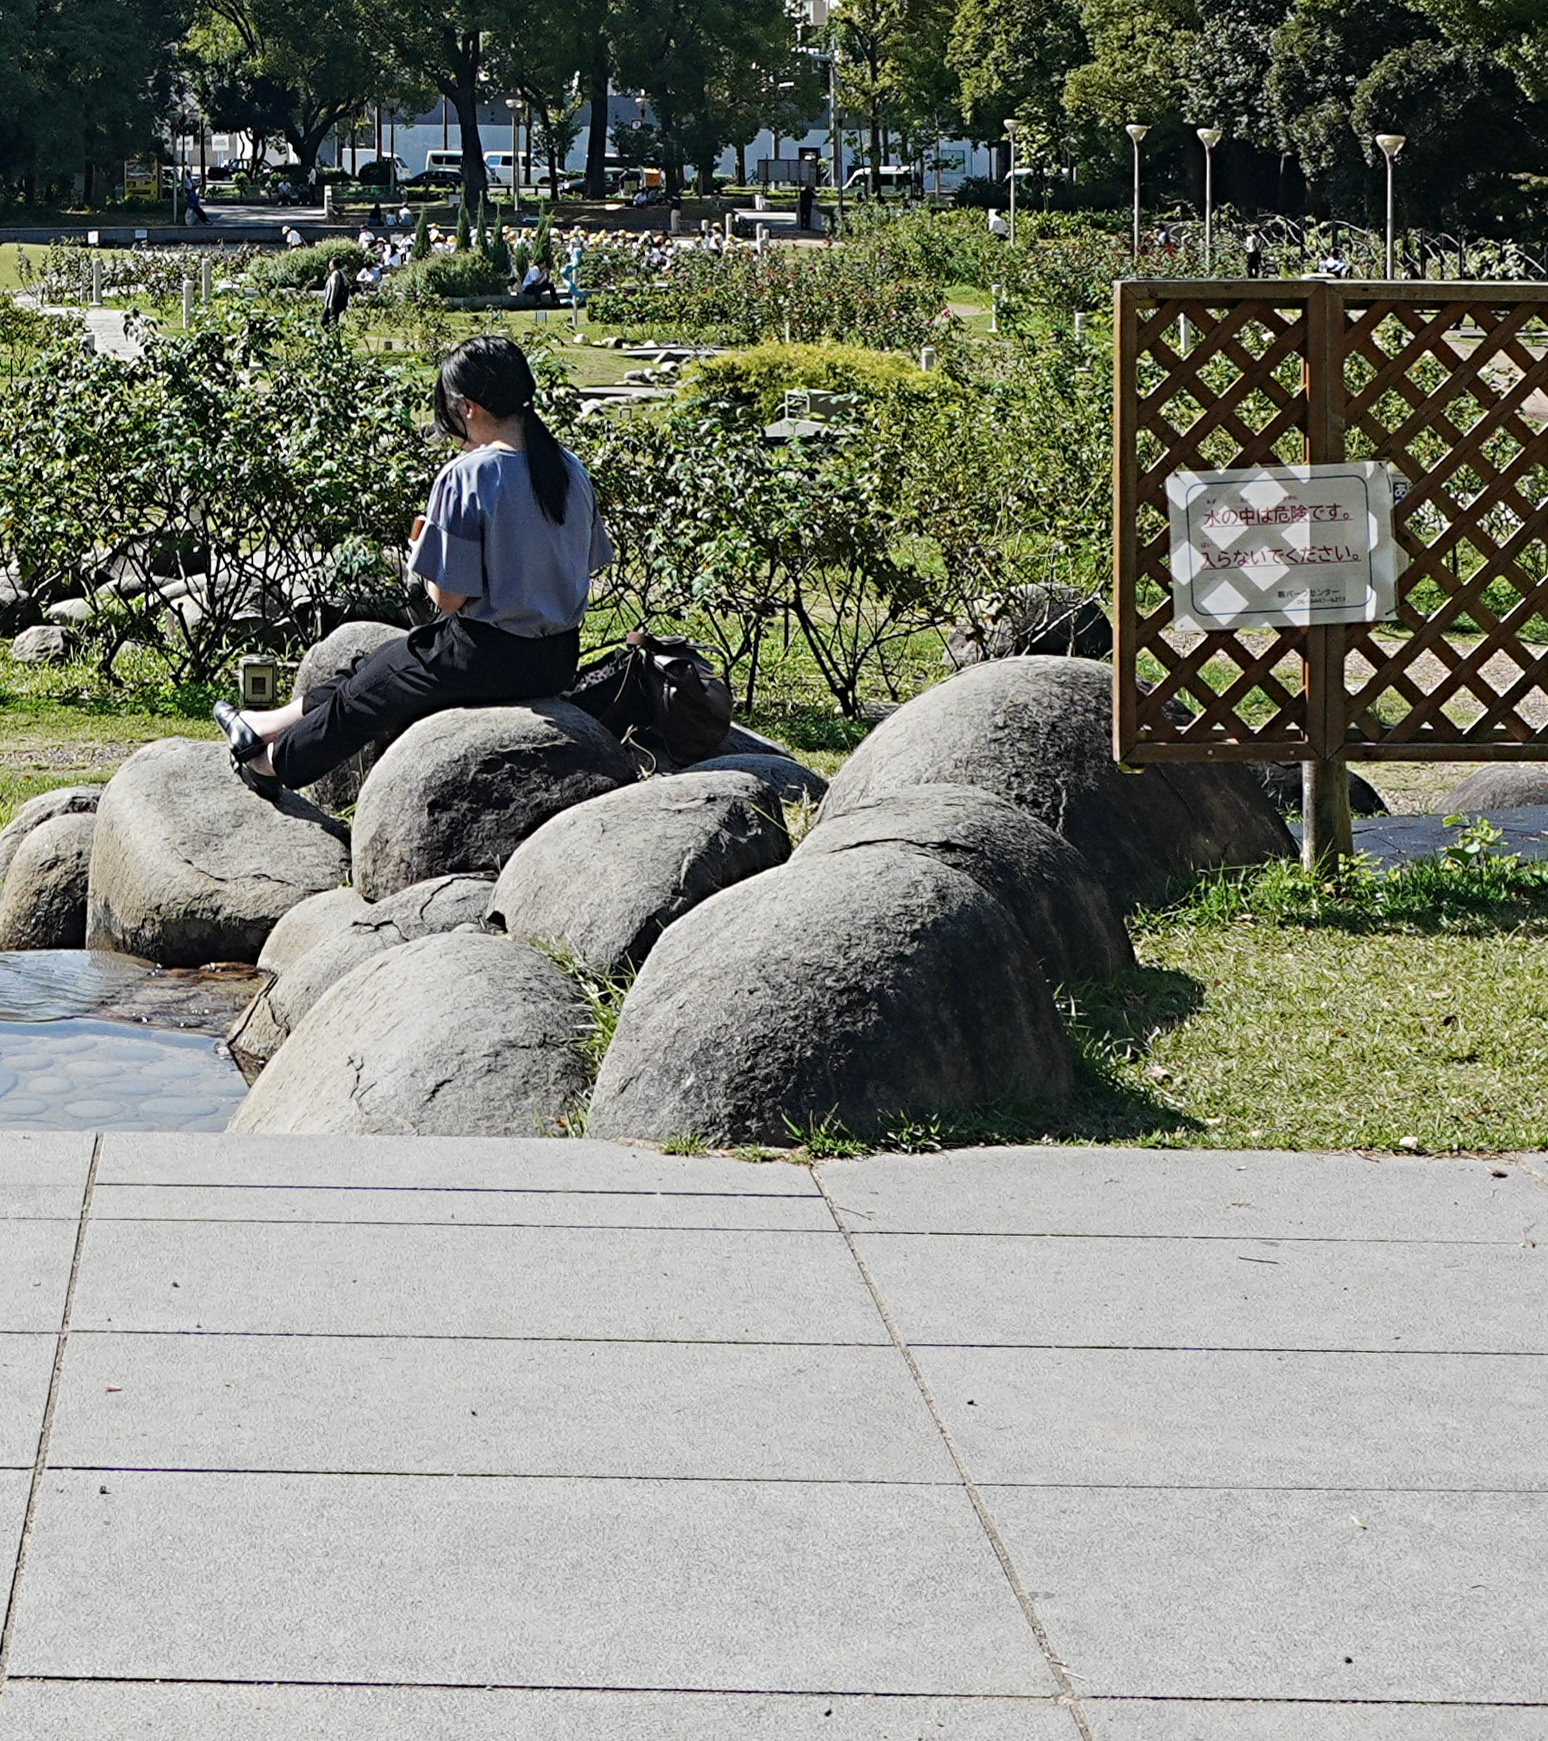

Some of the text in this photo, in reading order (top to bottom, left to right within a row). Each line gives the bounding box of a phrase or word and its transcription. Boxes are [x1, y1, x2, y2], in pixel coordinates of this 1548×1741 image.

[1203, 503, 1350, 527] 水の中は危険です。
[1201, 545, 1360, 570] 入らないでください。
[1277, 588, 1340, 598] パークセンター
